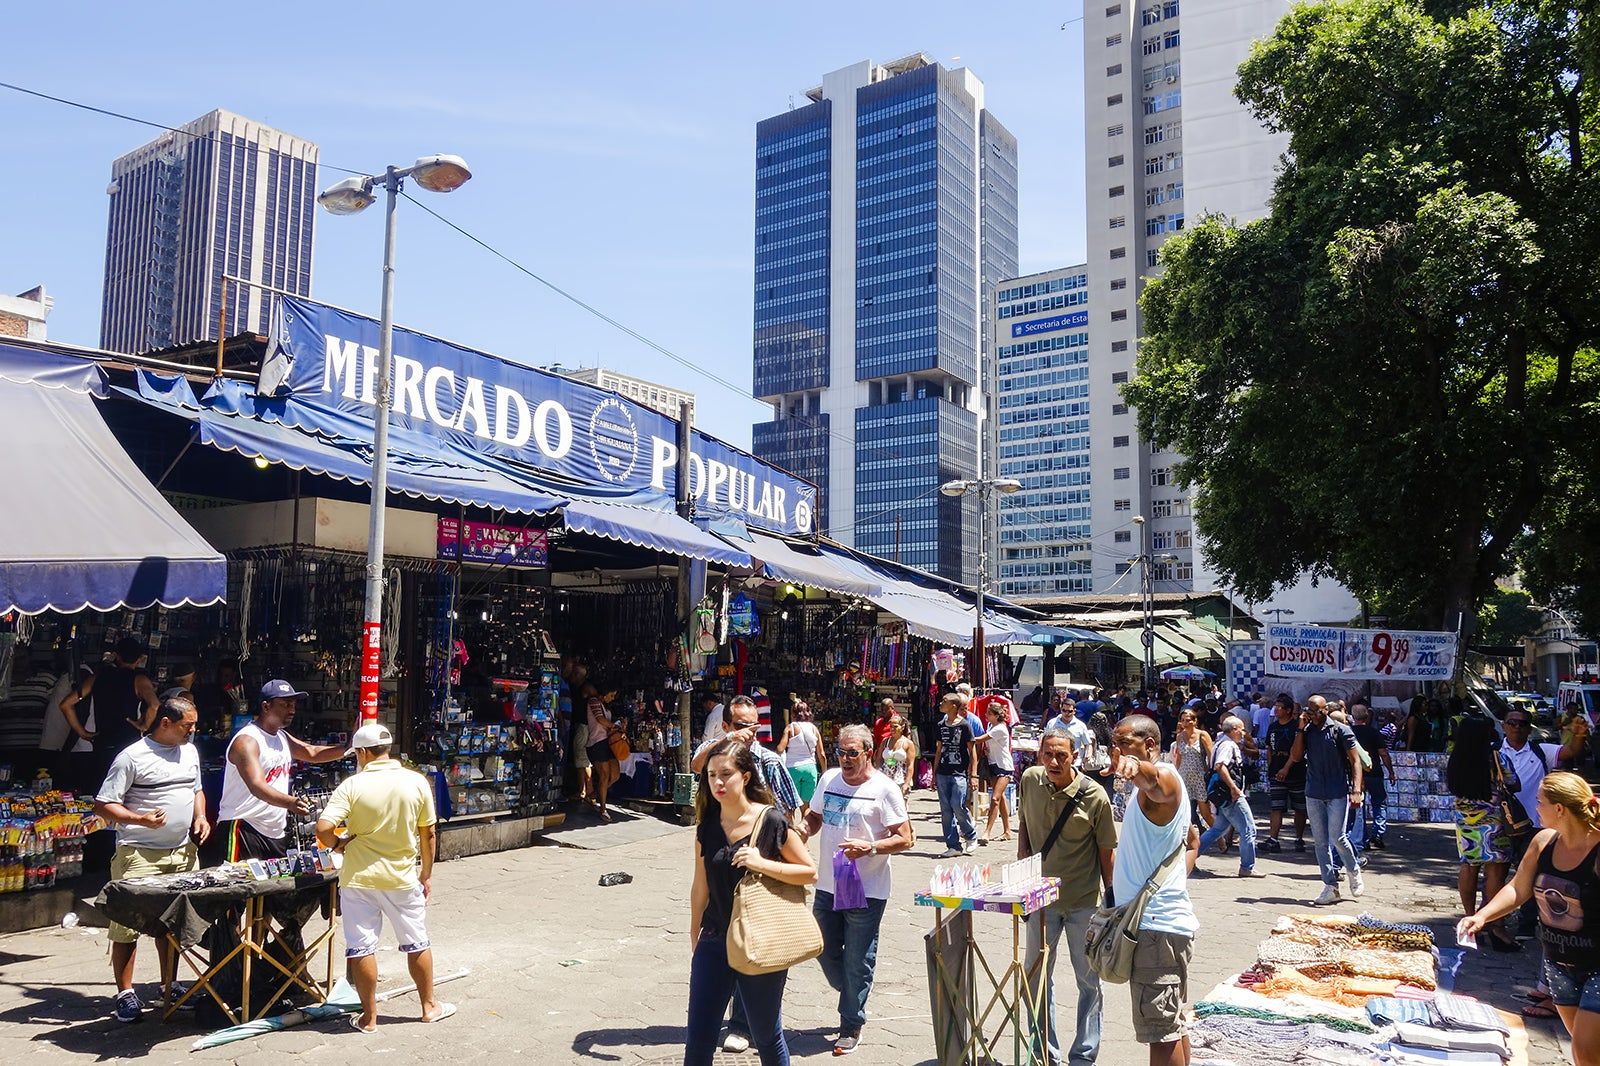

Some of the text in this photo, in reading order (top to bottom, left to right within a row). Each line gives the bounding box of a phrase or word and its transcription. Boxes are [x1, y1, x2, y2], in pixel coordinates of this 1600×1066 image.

[1025, 320, 1060, 332] Secretaria
[1061, 317, 1070, 325] de
[321, 334, 786, 524] MERCADO POPULAR
[1270, 627, 1297, 638] GRANDE
[1270, 646, 1295, 662] CD'S
[1300, 648, 1335, 665] DVD'S
[1408, 667, 1416, 675] DE
